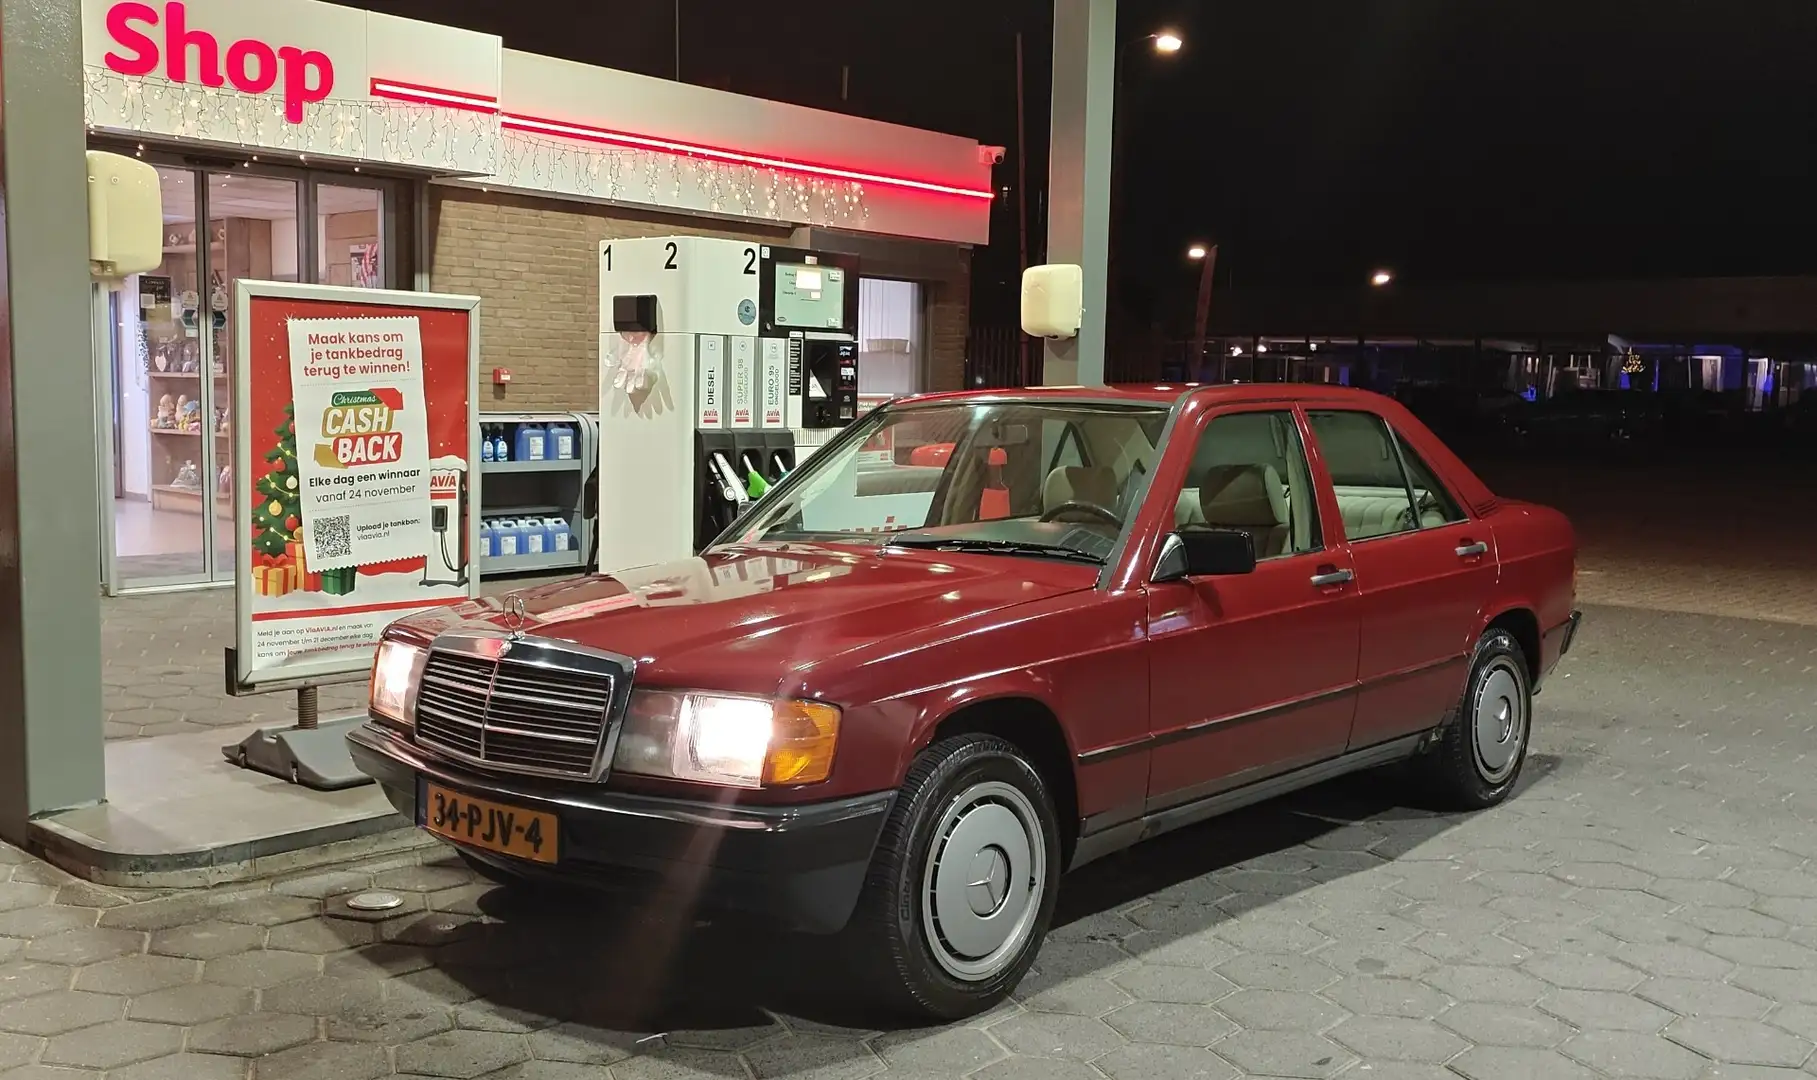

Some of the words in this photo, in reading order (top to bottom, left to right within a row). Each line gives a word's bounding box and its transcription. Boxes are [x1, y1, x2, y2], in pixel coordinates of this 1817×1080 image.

[104, 1, 334, 124] Shop
[603, 244, 612, 272] 1
[664, 242, 678, 270] 2
[743, 248, 756, 275] 2
[308, 333, 346, 346] Maak
[349, 331, 380, 344] kans
[383, 332, 404, 343] om
[310, 349, 323, 364] je
[325, 347, 403, 361] tankbedrag
[304, 366, 340, 379] terug
[343, 365, 357, 375] te
[359, 361, 411, 374] winnen!
[768, 365, 775, 376] 95
[707, 366, 715, 405] DIESEL
[333, 393, 377, 406] Christmas
[326, 406, 389, 436] CASH
[337, 434, 399, 464] BACK
[309, 476, 331, 488] Elke
[333, 473, 355, 487] dag
[357, 473, 377, 483] een
[379, 468, 421, 479] winnaar
[315, 490, 347, 503] vanaf
[349, 490, 362, 499] 24
[364, 484, 416, 499] november
[356, 522, 382, 533] Upload
[382, 521, 389, 530] je
[266, 639, 300, 647] november
[433, 792, 543, 854] 34-PJV-4
